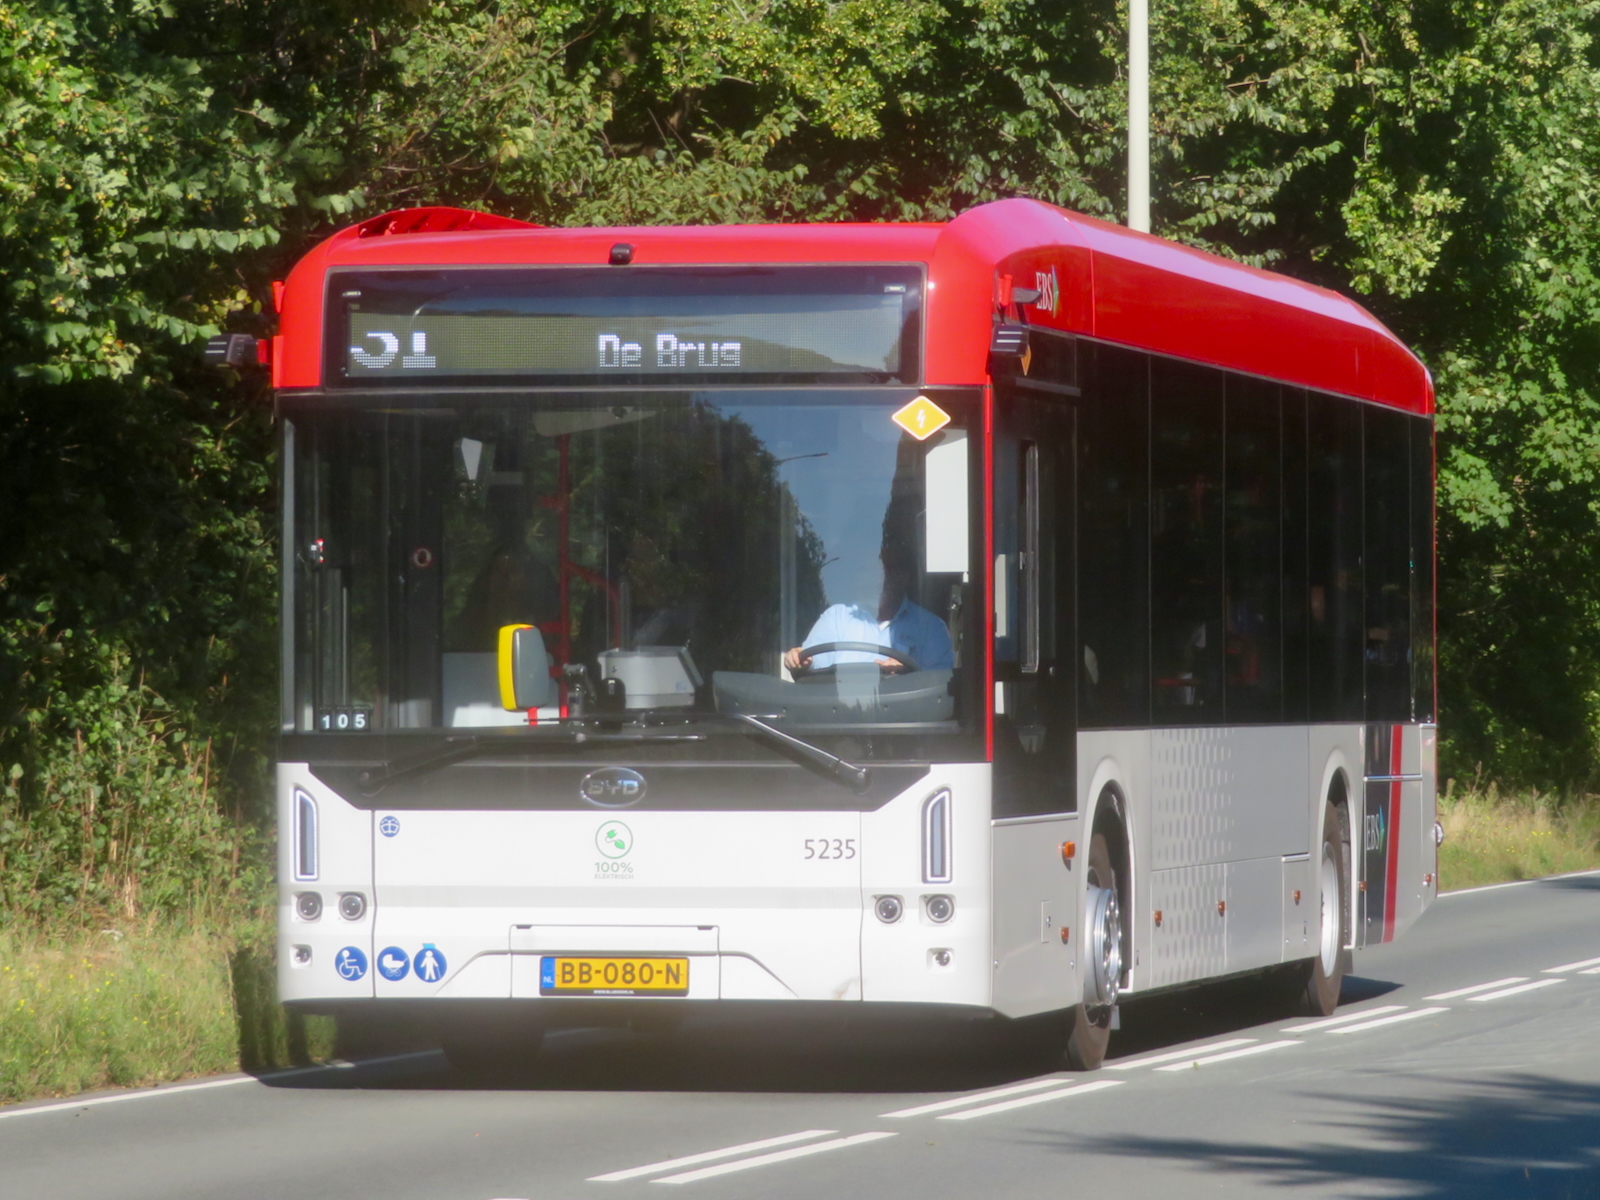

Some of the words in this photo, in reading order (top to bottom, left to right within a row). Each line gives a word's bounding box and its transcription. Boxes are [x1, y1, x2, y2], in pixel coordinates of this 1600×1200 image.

[1035, 272, 1053, 311] EBS
[599, 333, 642, 367] De
[657, 333, 741, 367] Brug
[322, 713, 366, 729] 105
[588, 780, 639, 795] BYD
[804, 839, 856, 860] 5235
[594, 862, 634, 873] 100%
[543, 975, 554, 983] NL
[561, 962, 681, 985] BB-080-N
